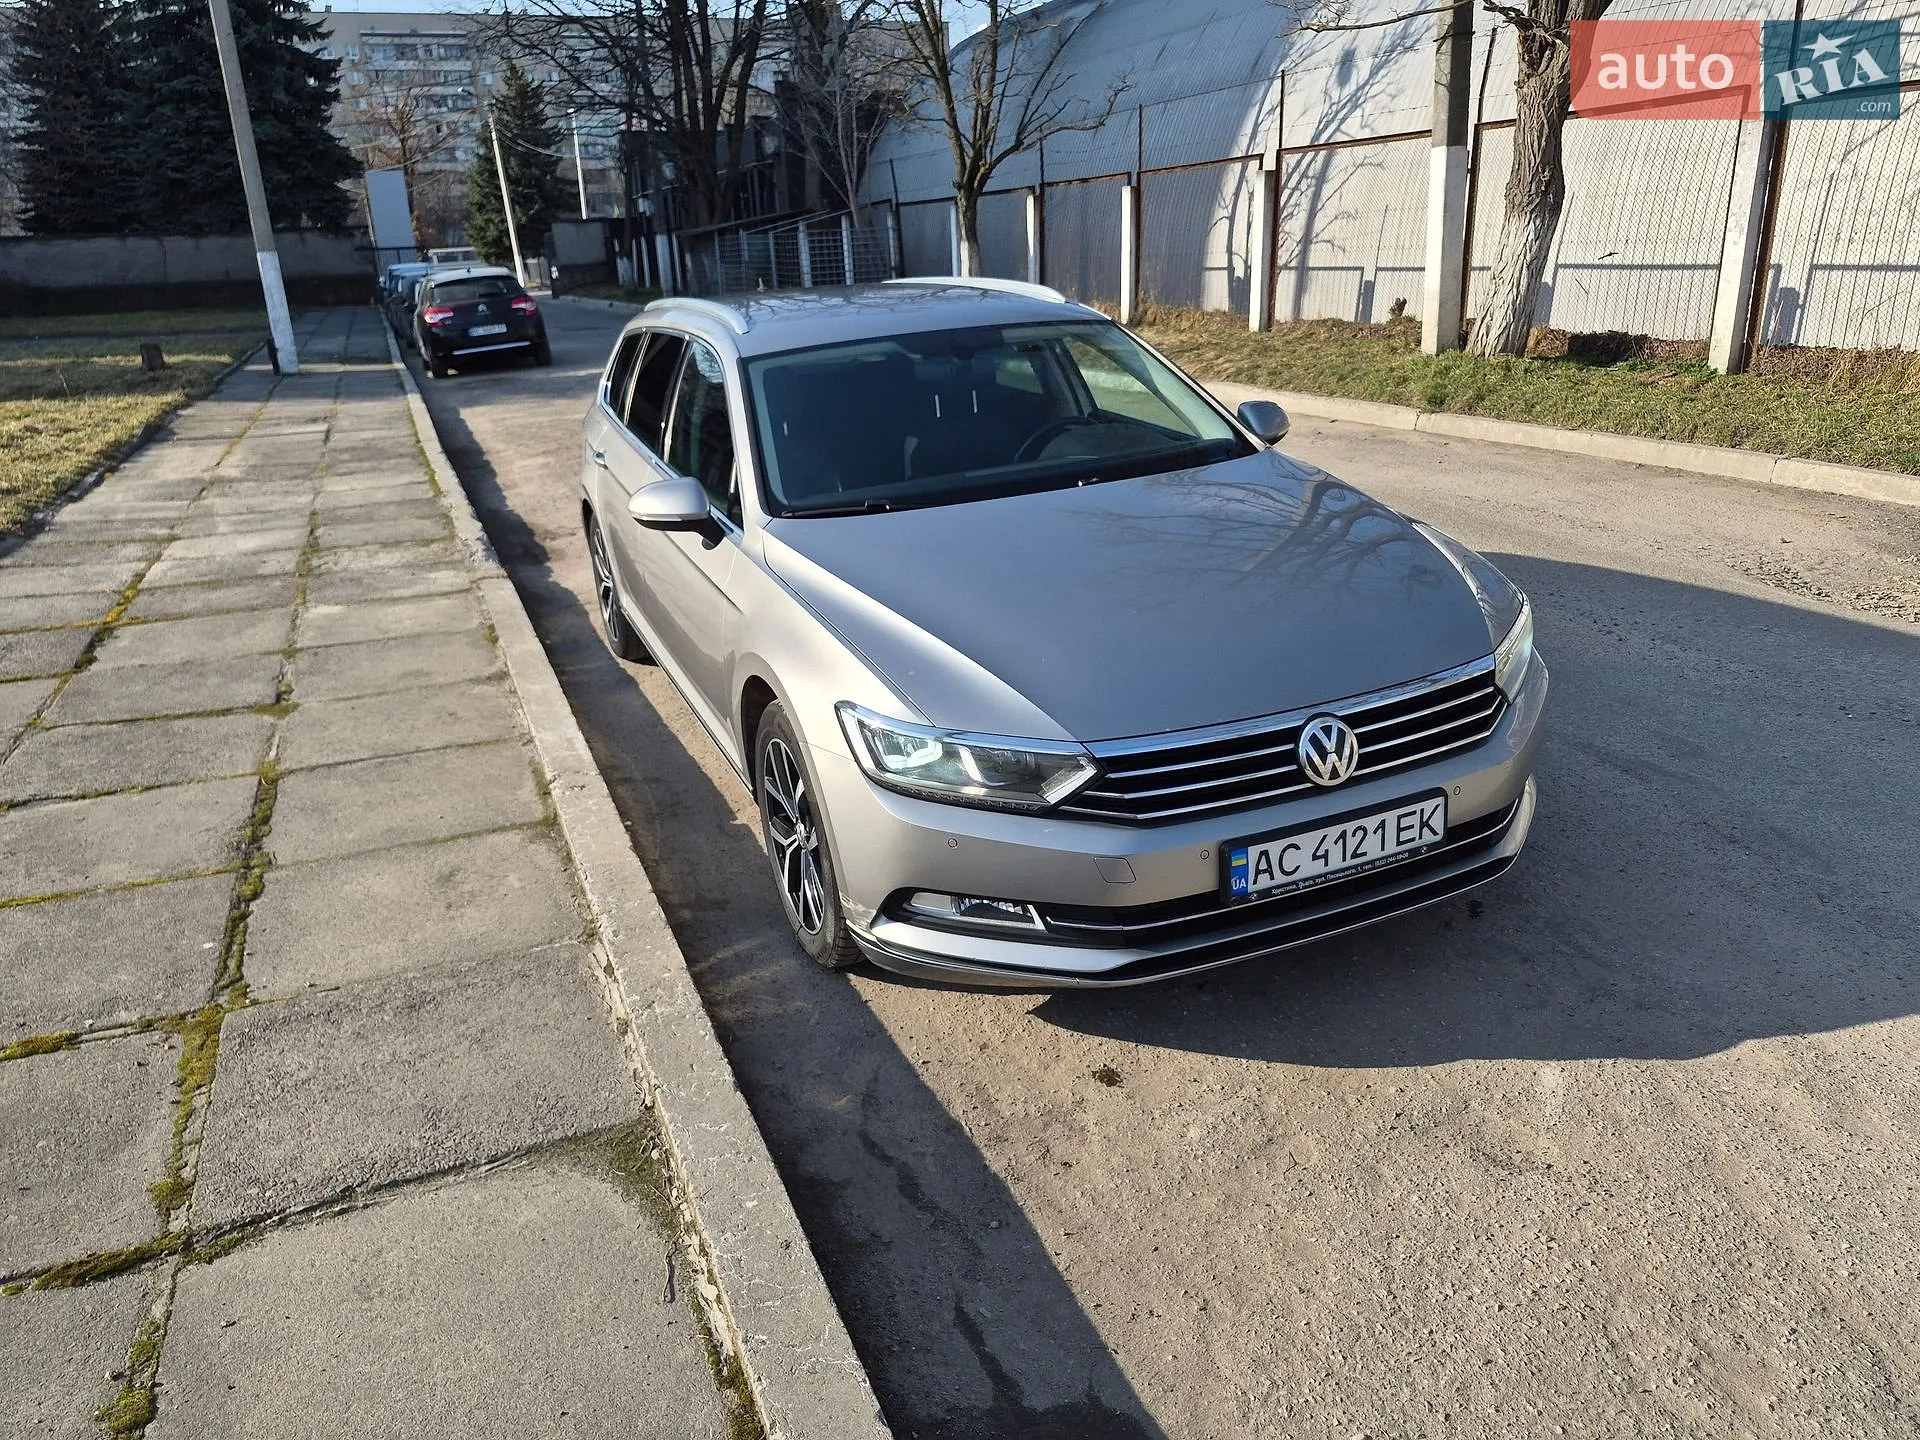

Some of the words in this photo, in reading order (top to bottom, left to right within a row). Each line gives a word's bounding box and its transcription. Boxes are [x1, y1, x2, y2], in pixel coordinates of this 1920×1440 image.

[1252, 843, 1301, 886] AC
[1312, 818, 1386, 867] 4121
[1396, 803, 1440, 847] EK
[1232, 878, 1247, 890] UA
